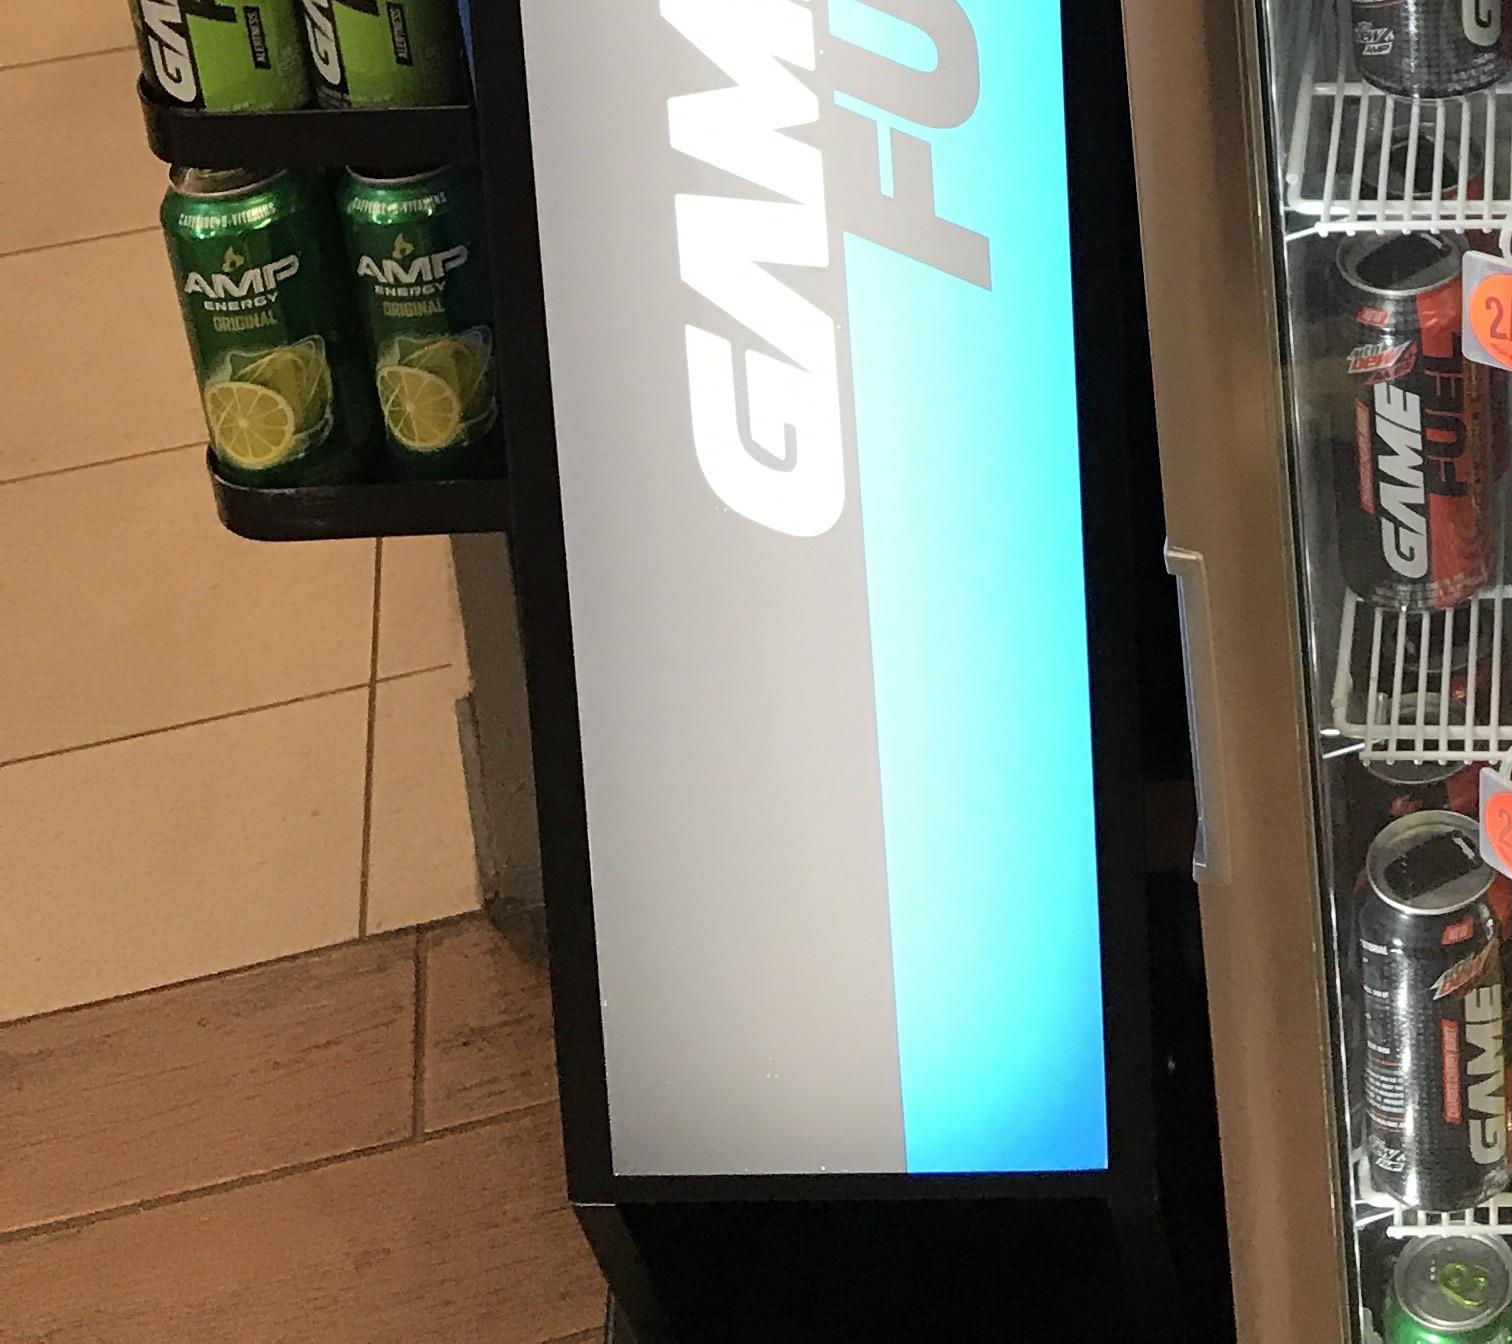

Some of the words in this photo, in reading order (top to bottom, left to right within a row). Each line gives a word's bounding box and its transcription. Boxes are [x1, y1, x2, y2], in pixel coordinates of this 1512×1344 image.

[246, 12, 267, 63] ALERTNESS
[183, 254, 300, 299] AMP
[356, 245, 469, 285] AMP
[203, 292, 278, 311] ENERGY
[375, 281, 446, 298] ENERGY
[383, 298, 445, 318] ORIGINAL
[212, 310, 278, 333] ORIGINAL
[1373, 383, 1429, 579] GAME
[1465, 984, 1503, 1165] GAME
